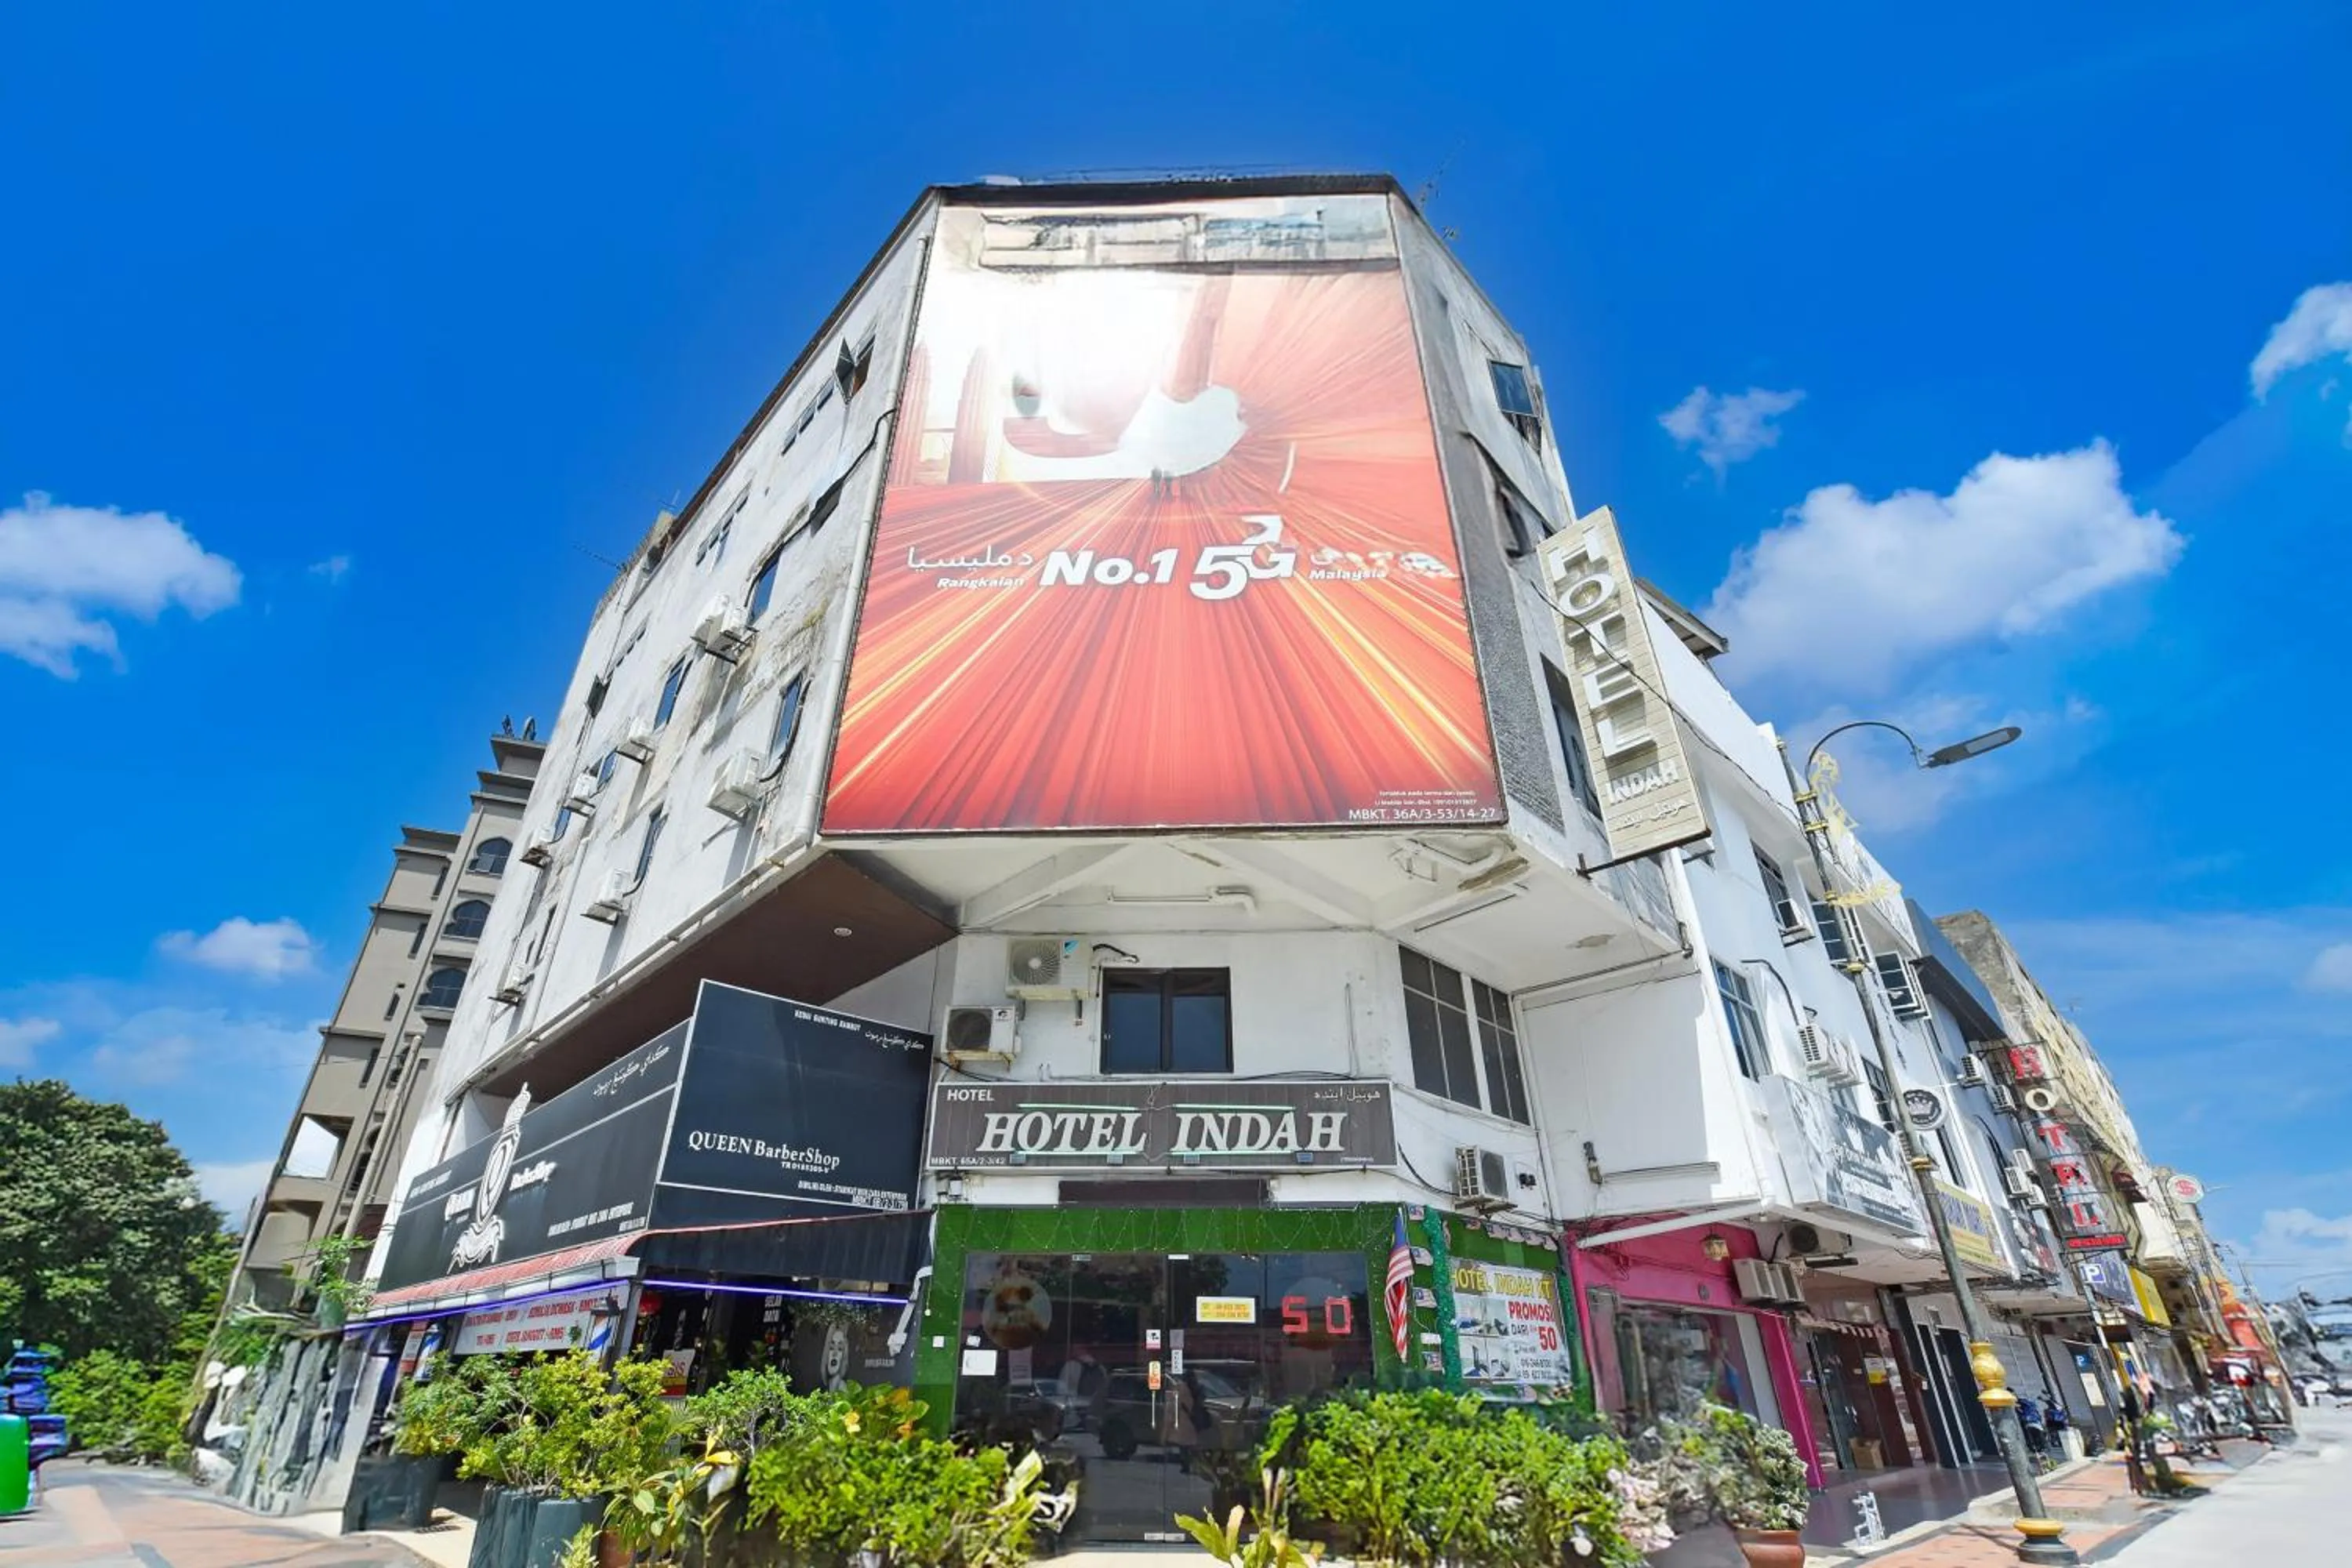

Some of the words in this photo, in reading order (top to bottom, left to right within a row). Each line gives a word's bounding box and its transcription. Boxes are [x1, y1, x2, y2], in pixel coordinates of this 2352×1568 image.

[1040, 547, 1180, 586] No.1
[1189, 541, 1296, 601] 5G
[1308, 569, 1387, 582] Malaysia
[1607, 758, 1681, 805] INDAH
[1348, 808, 1390, 820] MBKT.
[946, 1088, 996, 1102] HOTEL
[975, 1111, 1147, 1152] HOTEL
[1170, 1112, 1348, 1152] INDAH
[688, 1131, 753, 1155] QUEEN
[754, 1140, 840, 1170] BarberShop
[1538, 1326, 1558, 1351] 50
